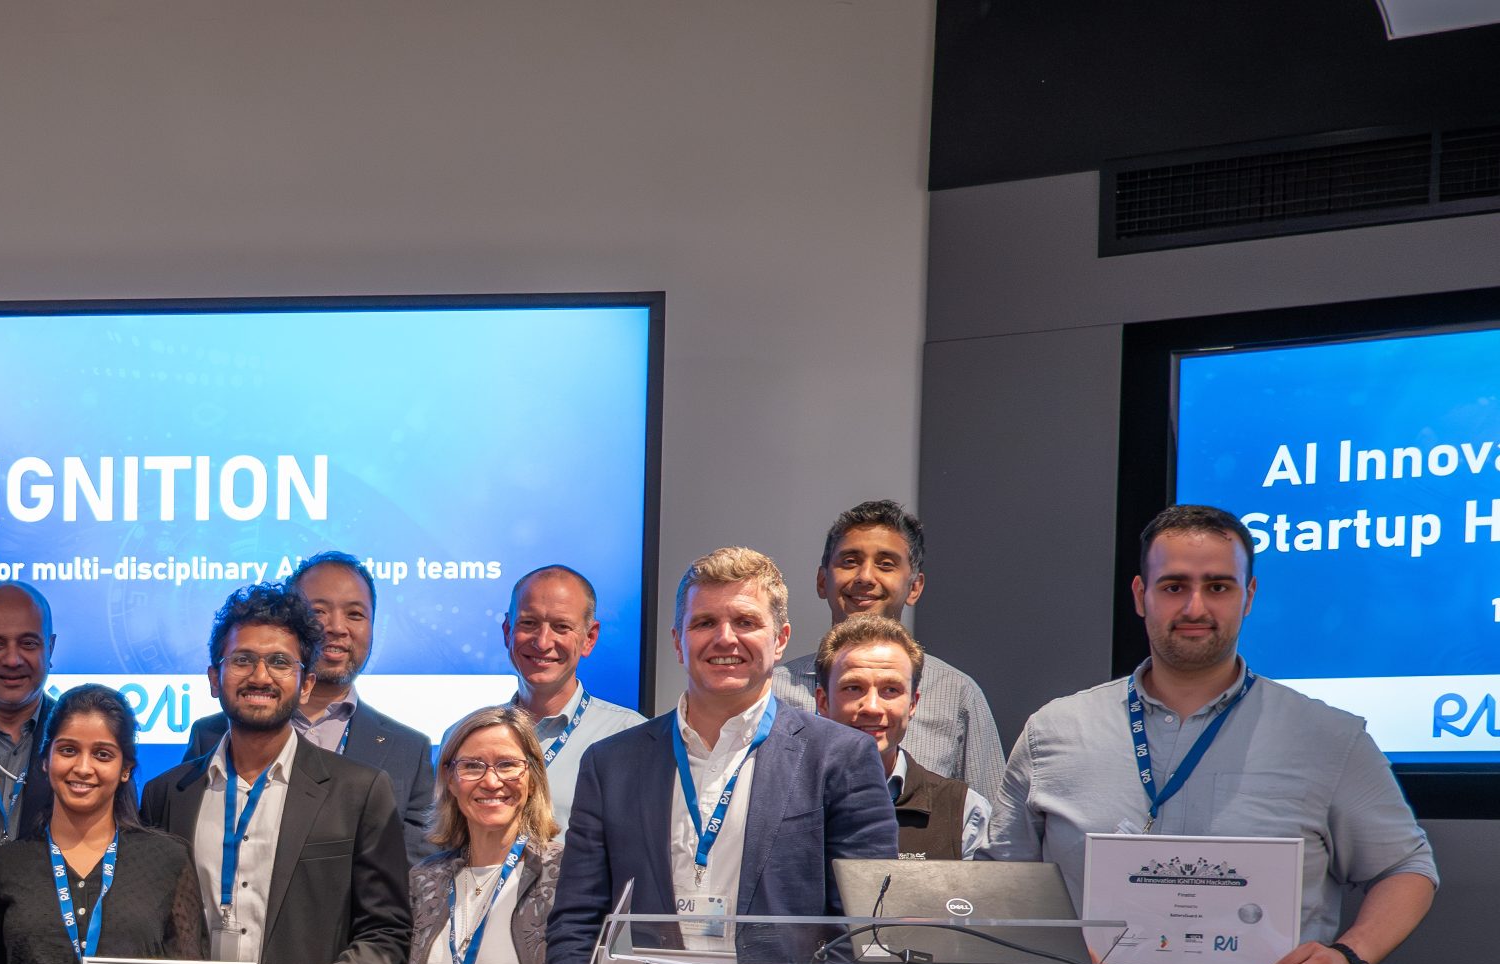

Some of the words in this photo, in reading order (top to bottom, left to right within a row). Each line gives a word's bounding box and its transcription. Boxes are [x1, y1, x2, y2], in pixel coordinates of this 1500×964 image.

[1262, 442, 1317, 487] AI
[1239, 509, 1442, 557] Startup
[32, 556, 268, 587] multi-disciplinary
[417, 557, 502, 579] teams
[1214, 935, 1239, 951] RAi
